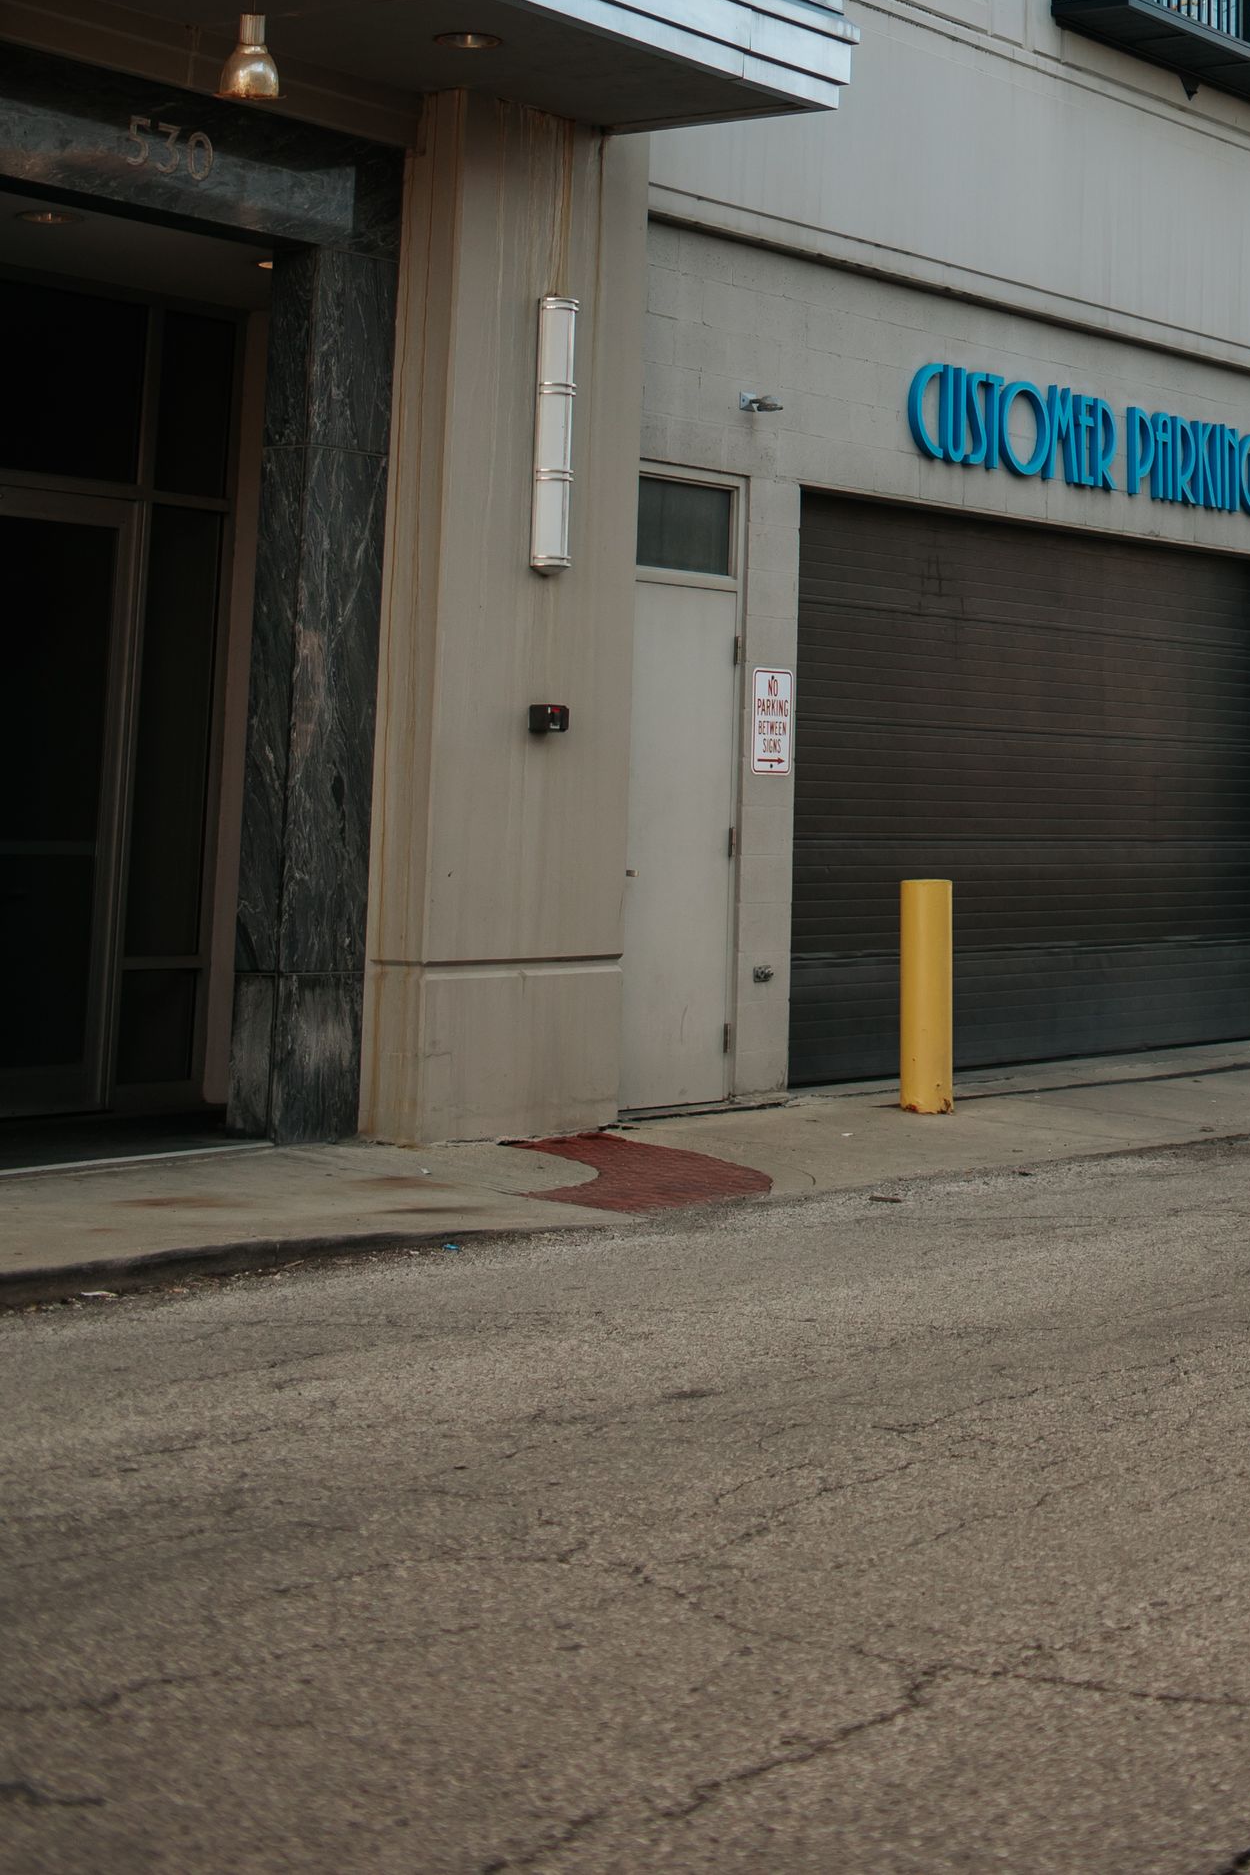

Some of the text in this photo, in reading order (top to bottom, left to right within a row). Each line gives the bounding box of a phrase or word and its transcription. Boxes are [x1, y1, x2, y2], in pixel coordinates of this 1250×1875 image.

[126, 115, 214, 181] 530
[907, 363, 1117, 491] CUSTOMER
[767, 679, 779, 697] NO
[757, 698, 789, 717] PARKING
[758, 720, 787, 736] BETWEEN
[762, 738, 782, 754] SIGNS
